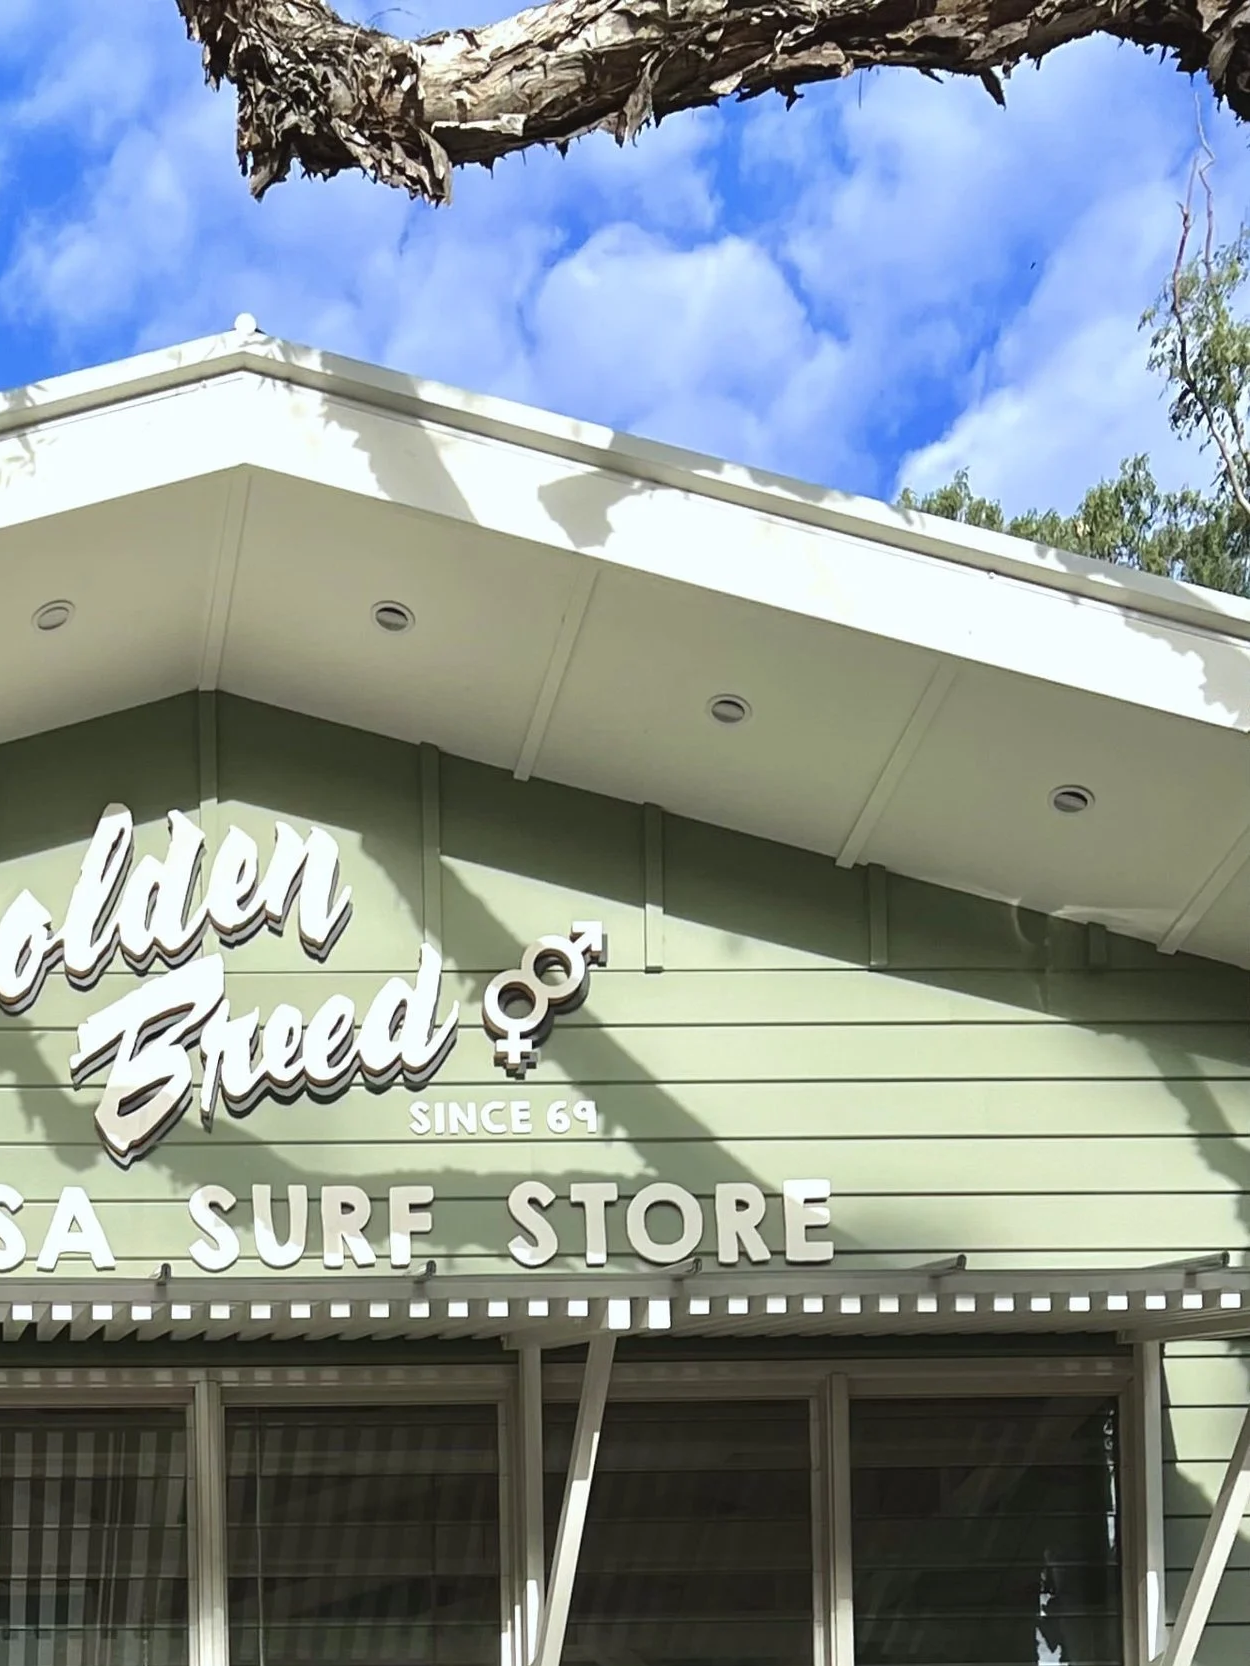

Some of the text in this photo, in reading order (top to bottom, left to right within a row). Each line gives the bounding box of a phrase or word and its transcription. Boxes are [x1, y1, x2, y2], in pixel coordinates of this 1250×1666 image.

[71, 943, 458, 1162] Breed
[410, 1100, 599, 1135] SINCE 69
[188, 1183, 435, 1270] SURF
[508, 1178, 835, 1268] STORE
